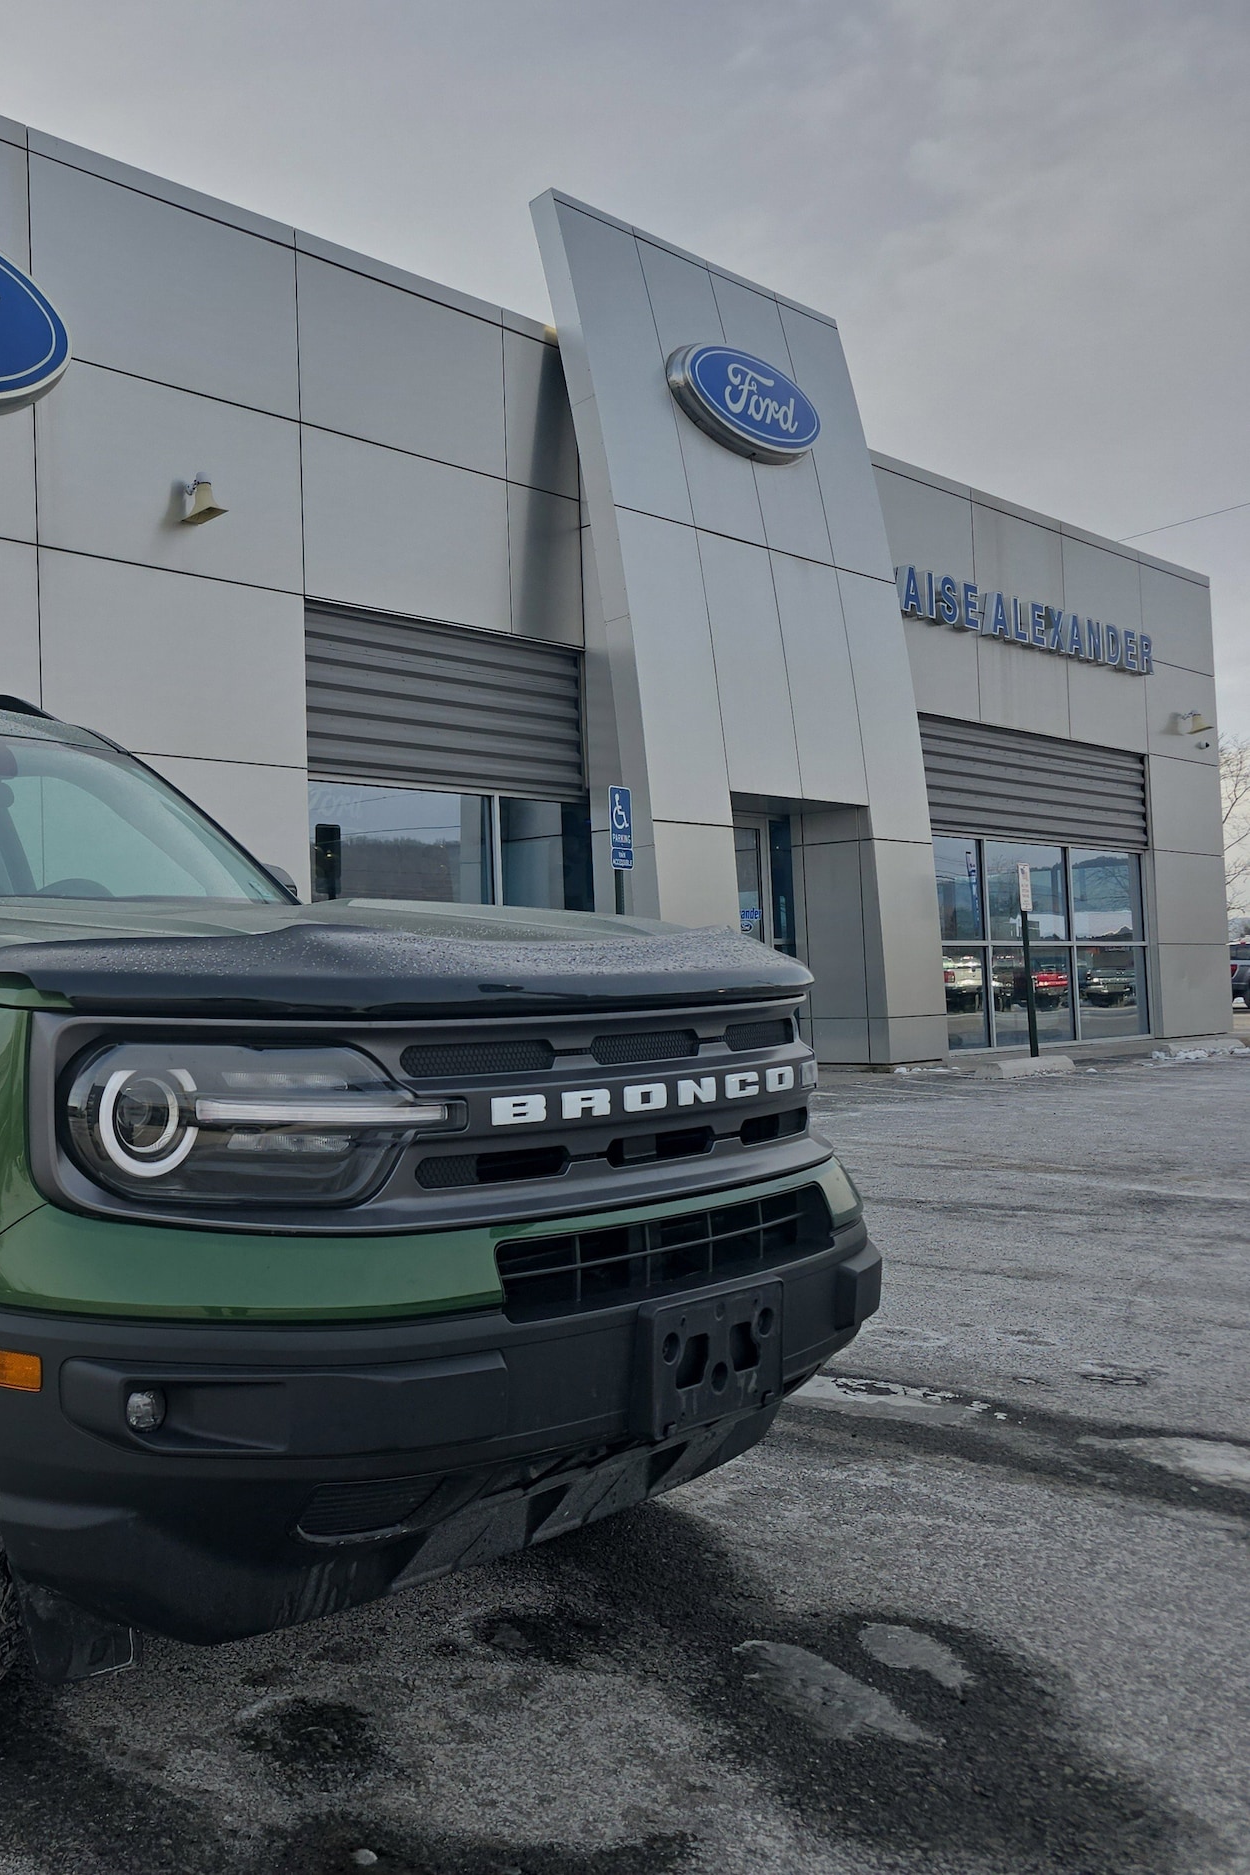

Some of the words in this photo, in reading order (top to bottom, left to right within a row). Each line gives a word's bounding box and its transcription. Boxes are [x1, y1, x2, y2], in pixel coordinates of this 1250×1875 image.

[724, 363, 798, 433] Ford
[901, 564, 980, 631] AISE
[991, 591, 1154, 675] ALEXANDER
[612, 833, 631, 844] PARKING
[740, 907, 762, 920] ander
[491, 1066, 794, 1126] BRONCO
